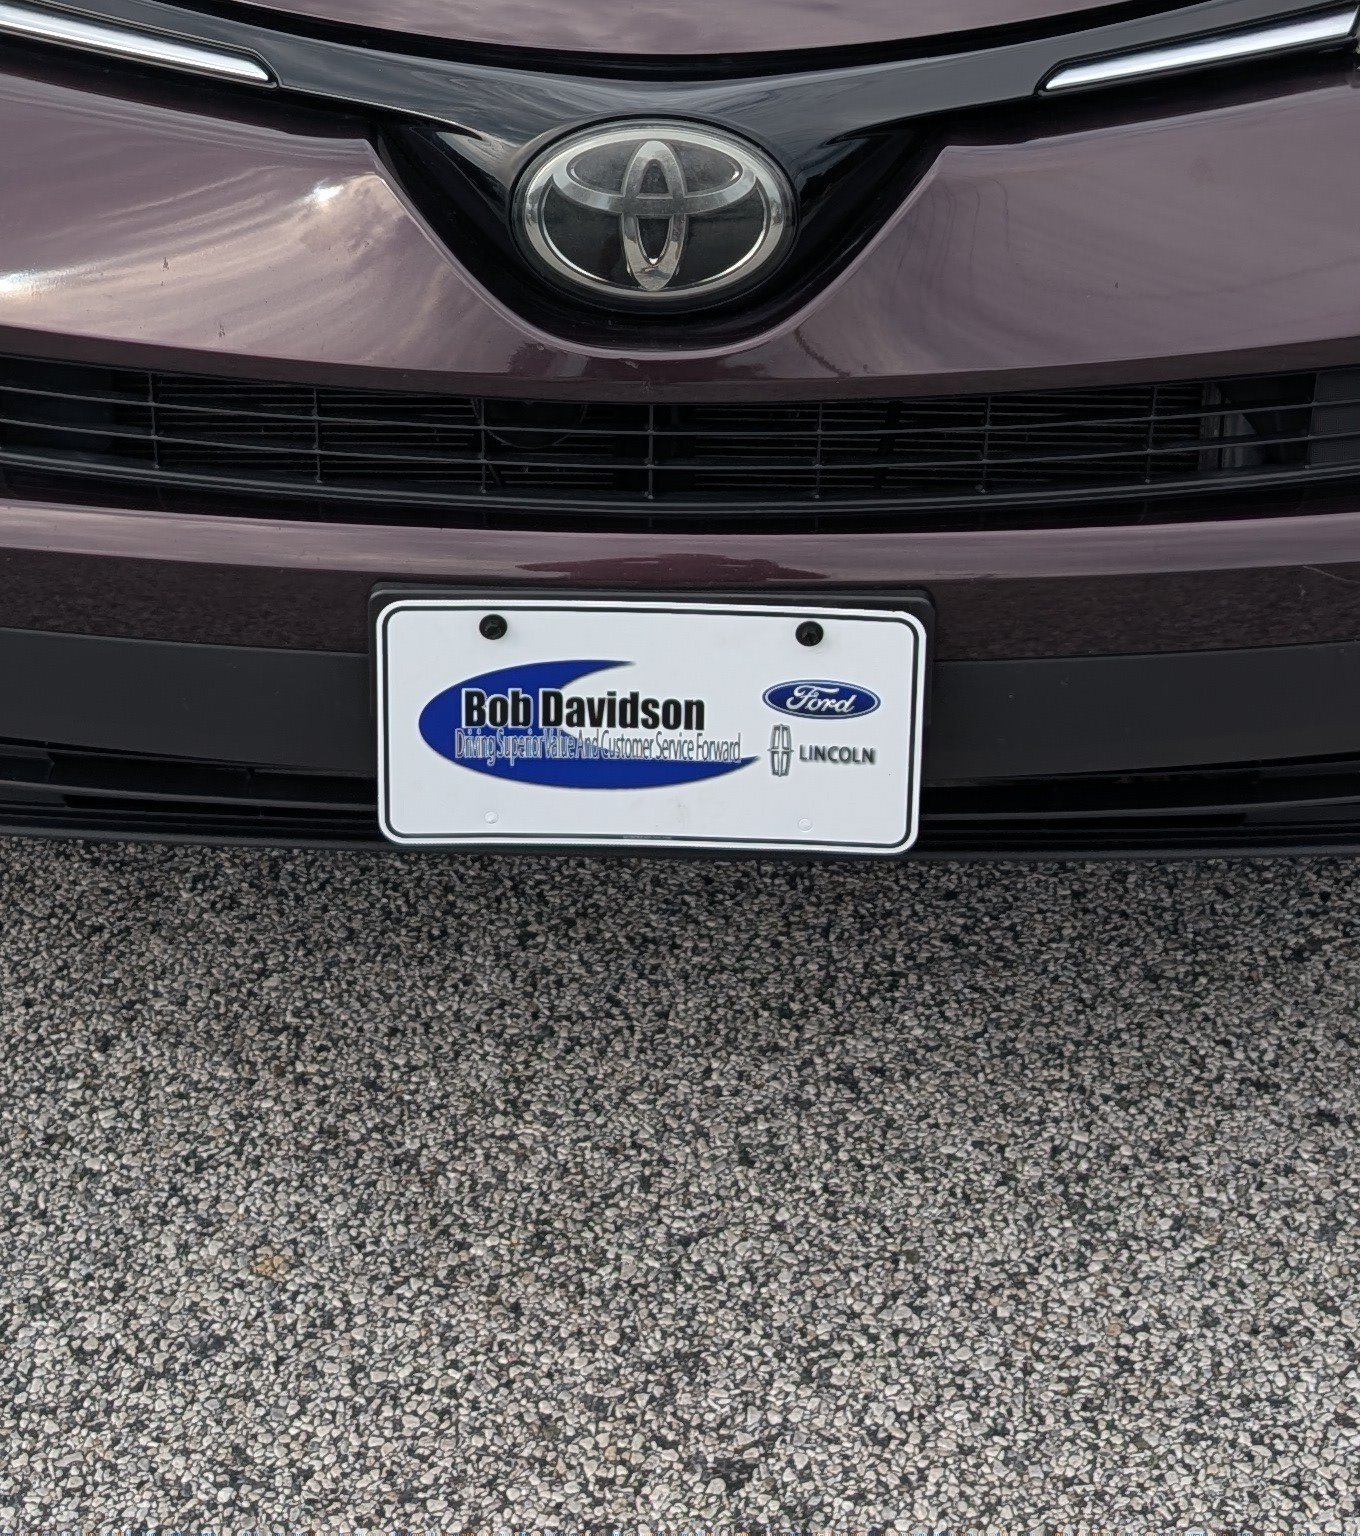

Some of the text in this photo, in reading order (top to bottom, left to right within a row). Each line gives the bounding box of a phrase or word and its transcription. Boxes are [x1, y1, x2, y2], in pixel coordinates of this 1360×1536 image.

[462, 687, 706, 732] Bob Davidson
[786, 684, 857, 713] Ford
[454, 728, 742, 766] Driving Superior Value And Customer Service Forward
[799, 744, 876, 765] LINCOLN
